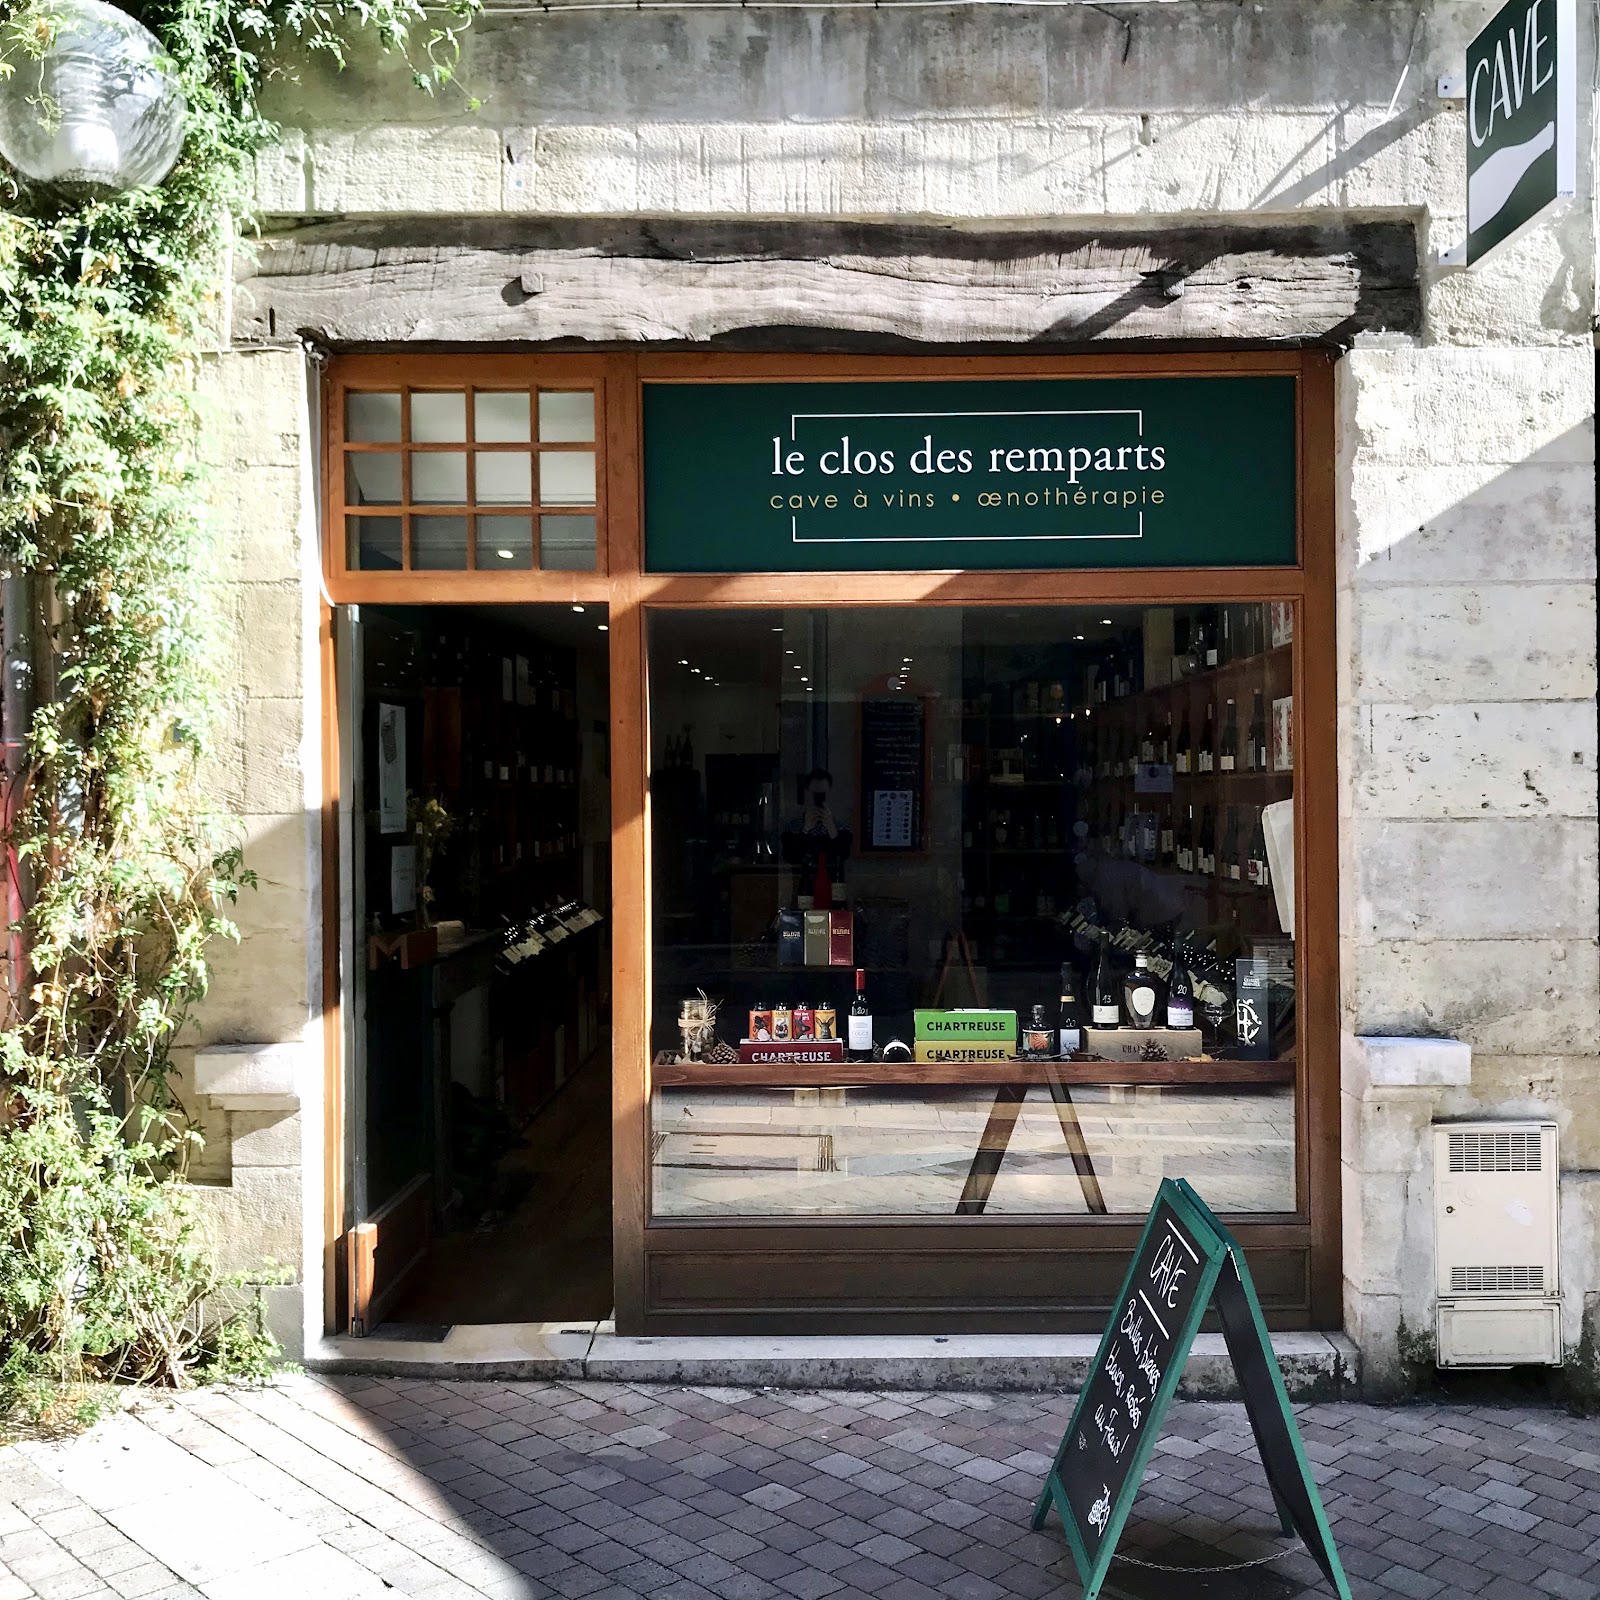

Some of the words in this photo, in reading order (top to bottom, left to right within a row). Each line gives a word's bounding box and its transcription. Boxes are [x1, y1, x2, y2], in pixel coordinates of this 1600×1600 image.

[1469, 0, 1554, 148] CAVE
[771, 436, 805, 475] le
[819, 435, 895, 475] clos
[909, 434, 973, 474] des
[988, 443, 1166, 484] remparts
[769, 490, 839, 509] cave
[853, 489, 868, 508] à
[883, 488, 935, 508] vins
[977, 485, 1166, 509] œnothérapie
[926, 1021, 1006, 1032] CHARTREUSE
[926, 1049, 1006, 1060] CHARTREUSE
[1149, 1234, 1187, 1309] CAVE
